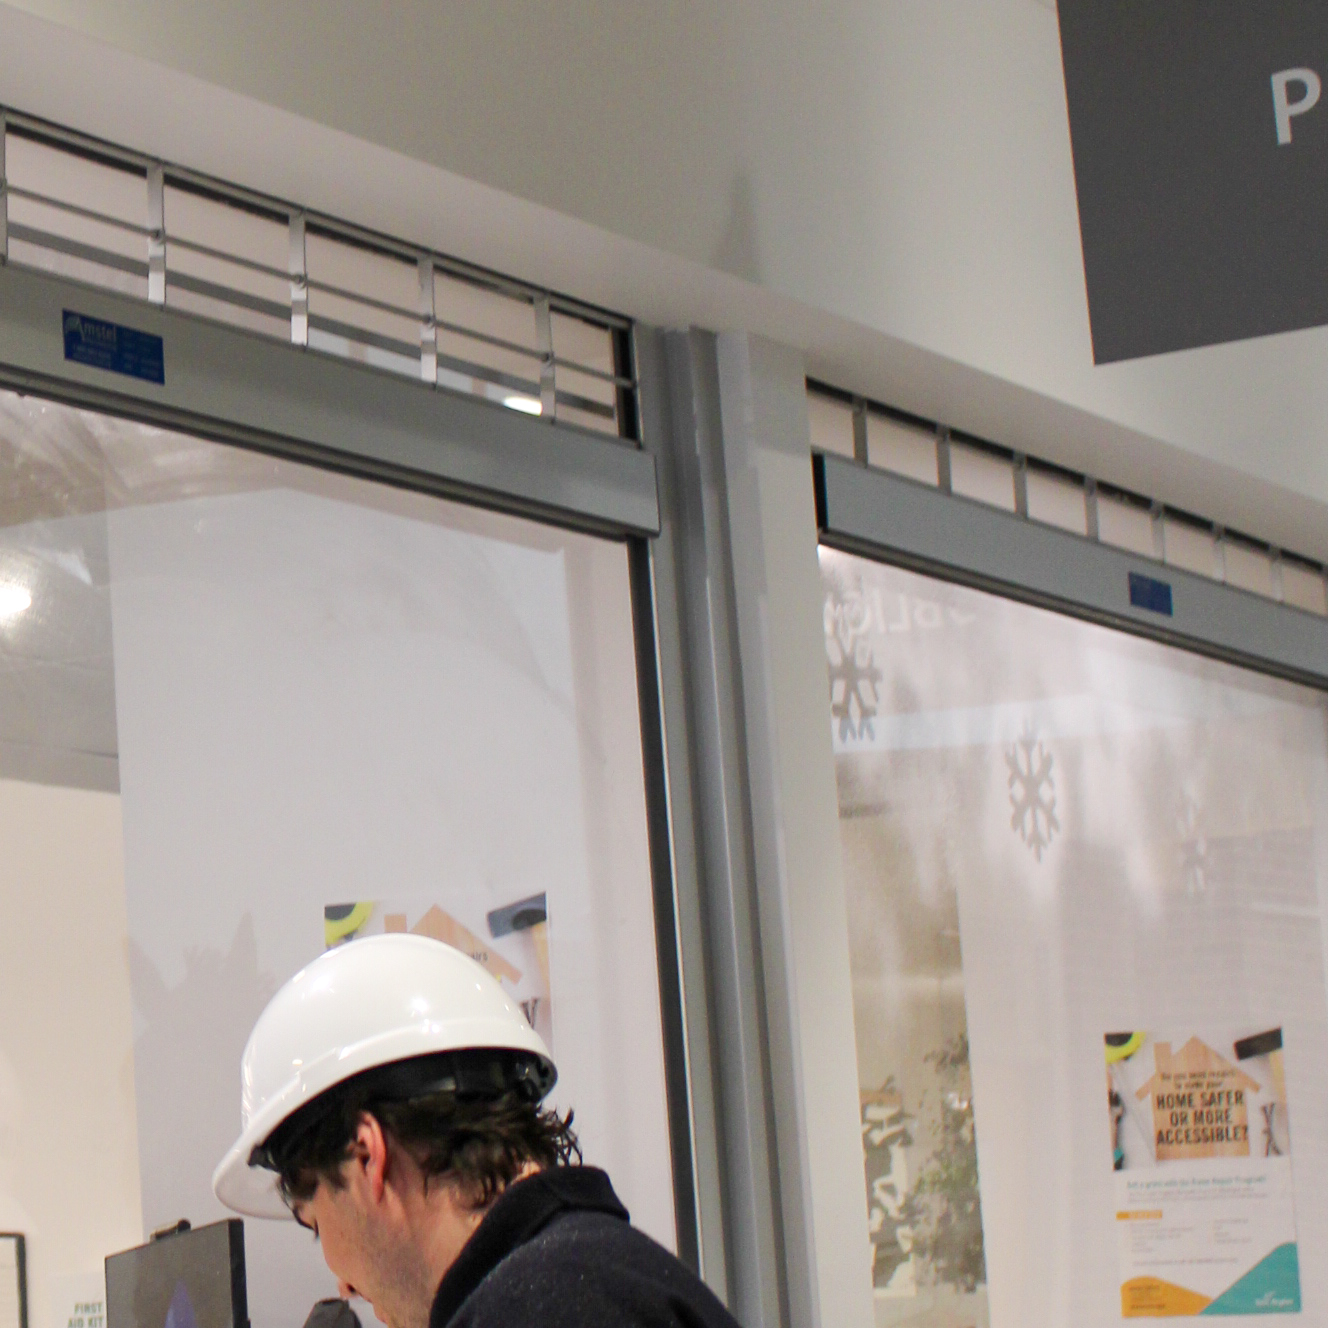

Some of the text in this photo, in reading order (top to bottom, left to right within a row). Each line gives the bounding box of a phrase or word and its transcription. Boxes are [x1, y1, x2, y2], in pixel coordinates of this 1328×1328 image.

[1271, 66, 1322, 146] P
[1157, 1089, 1244, 1110] HOME SAFER
[1169, 1108, 1233, 1127] OR MORE
[1157, 1125, 1249, 1145] ACCESSIBLE?
[74, 1302, 103, 1314] FIRST
[87, 1315, 103, 1328] KIT
